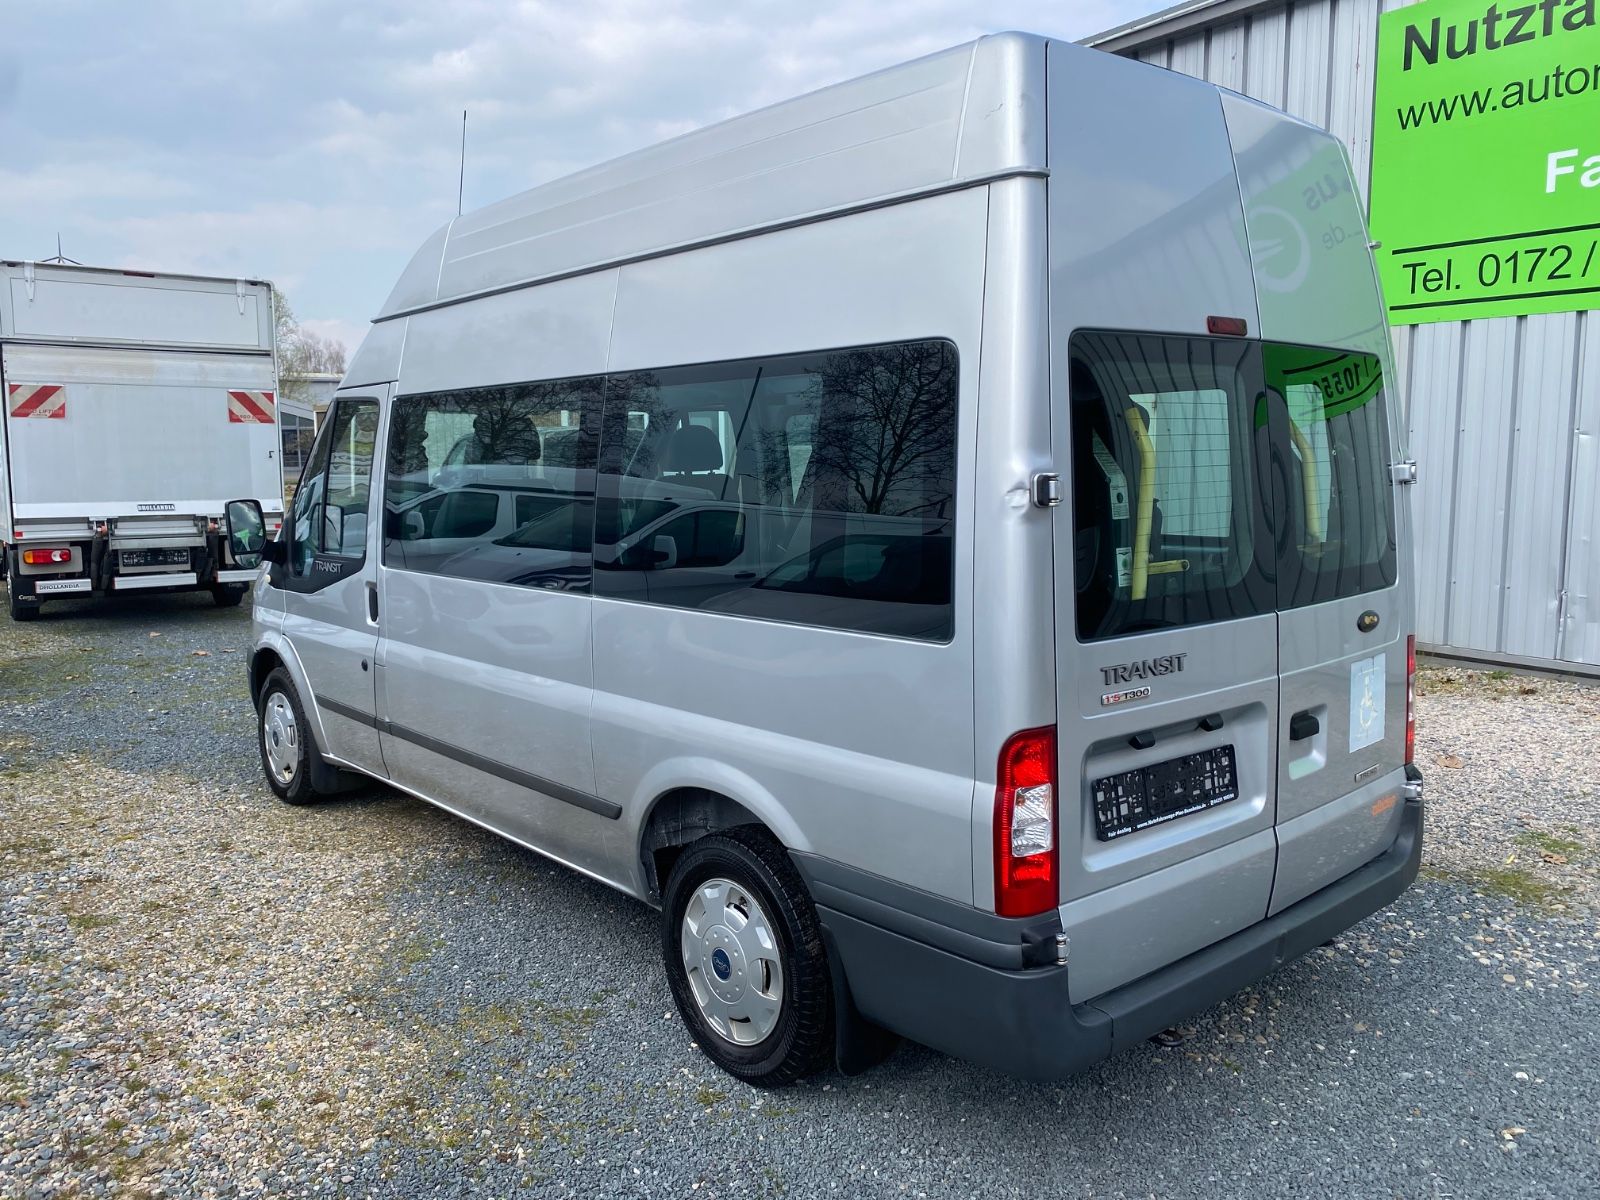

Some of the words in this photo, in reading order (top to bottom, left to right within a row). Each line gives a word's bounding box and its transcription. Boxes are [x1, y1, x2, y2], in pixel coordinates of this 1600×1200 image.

[1403, 0, 1596, 71] Nutzfa
[1545, 148, 1600, 193] Fa
[1402, 258, 1461, 295] Tel.
[1478, 244, 1572, 287] 0172
[1581, 240, 1597, 278] /
[315, 560, 342, 573] TRANSIT
[1100, 652, 1187, 685] TRANSIT
[1123, 688, 1150, 700] T300
